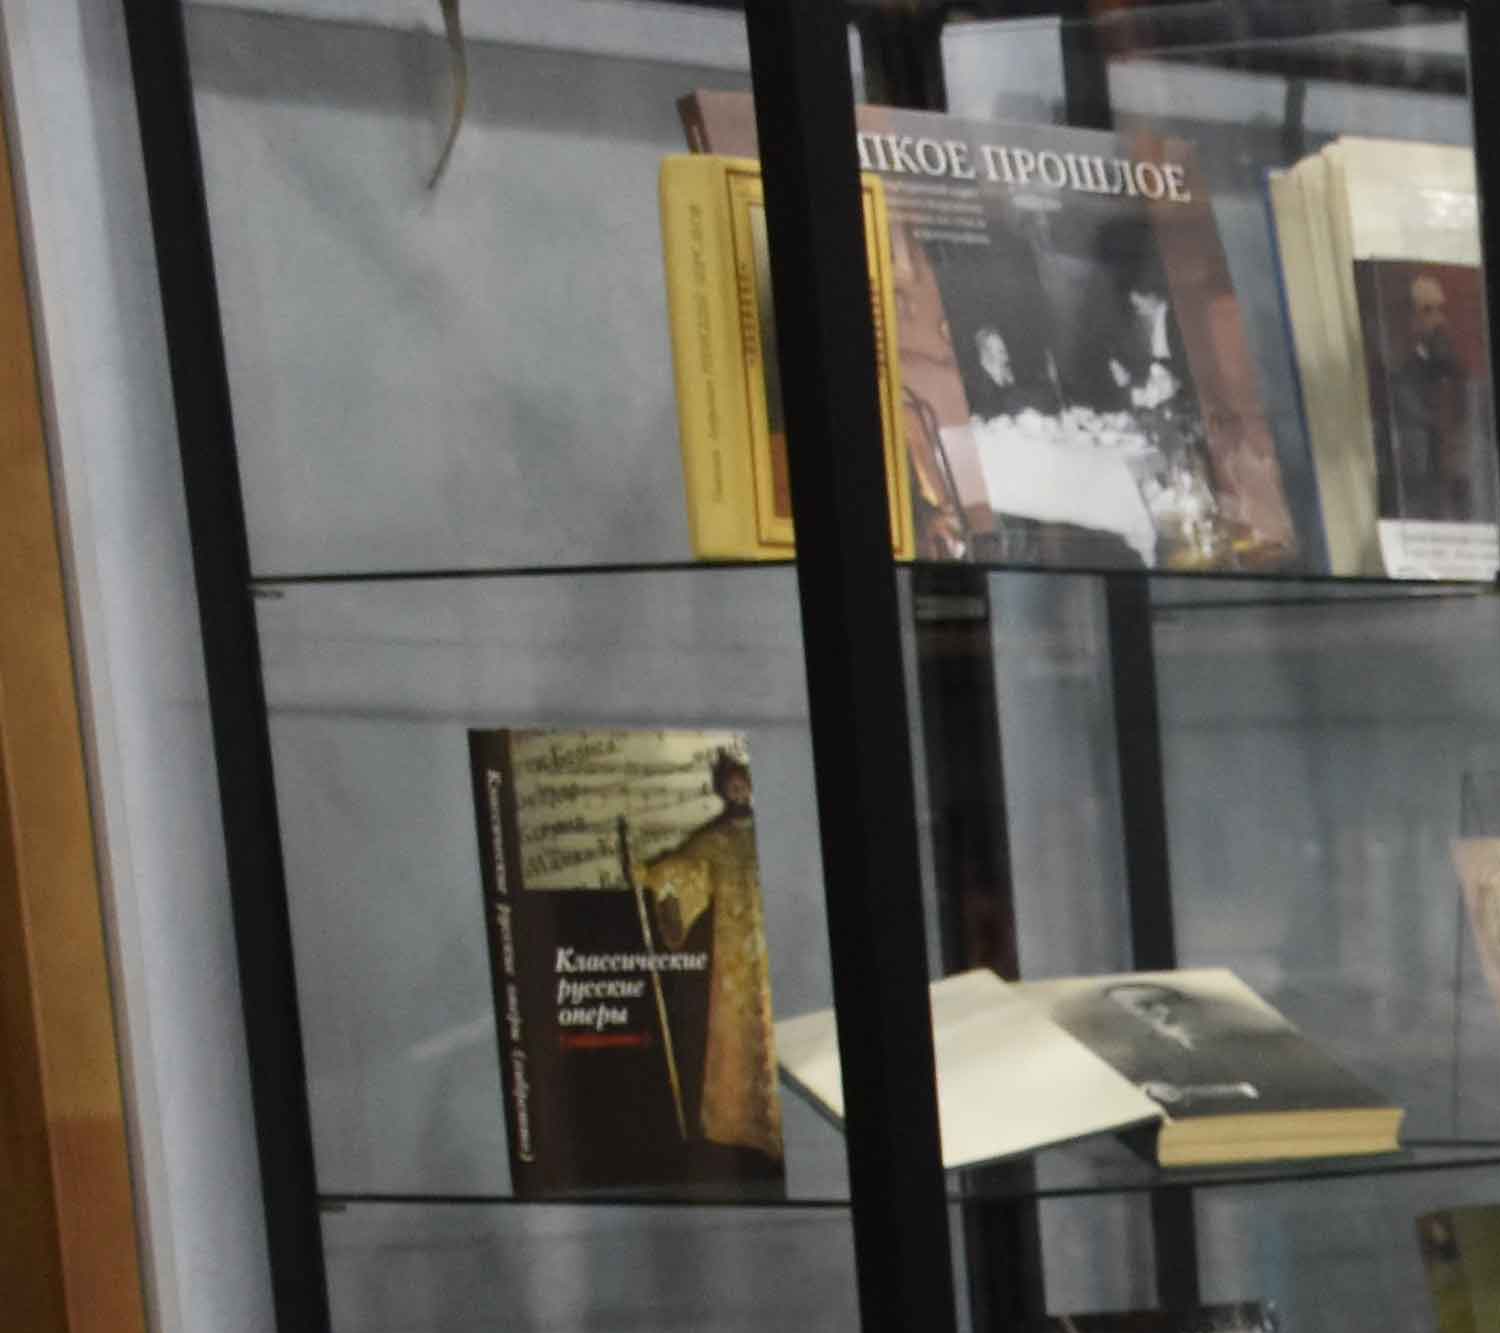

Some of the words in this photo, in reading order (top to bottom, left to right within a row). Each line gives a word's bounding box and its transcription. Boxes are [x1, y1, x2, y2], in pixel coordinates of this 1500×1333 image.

[856, 131, 978, 181] ПКОЕ
[980, 143, 1192, 204] ПРОШЛОЕ
[555, 946, 710, 974] Классические
[557, 977, 647, 1005] русские
[557, 1002, 630, 1033] оперы
